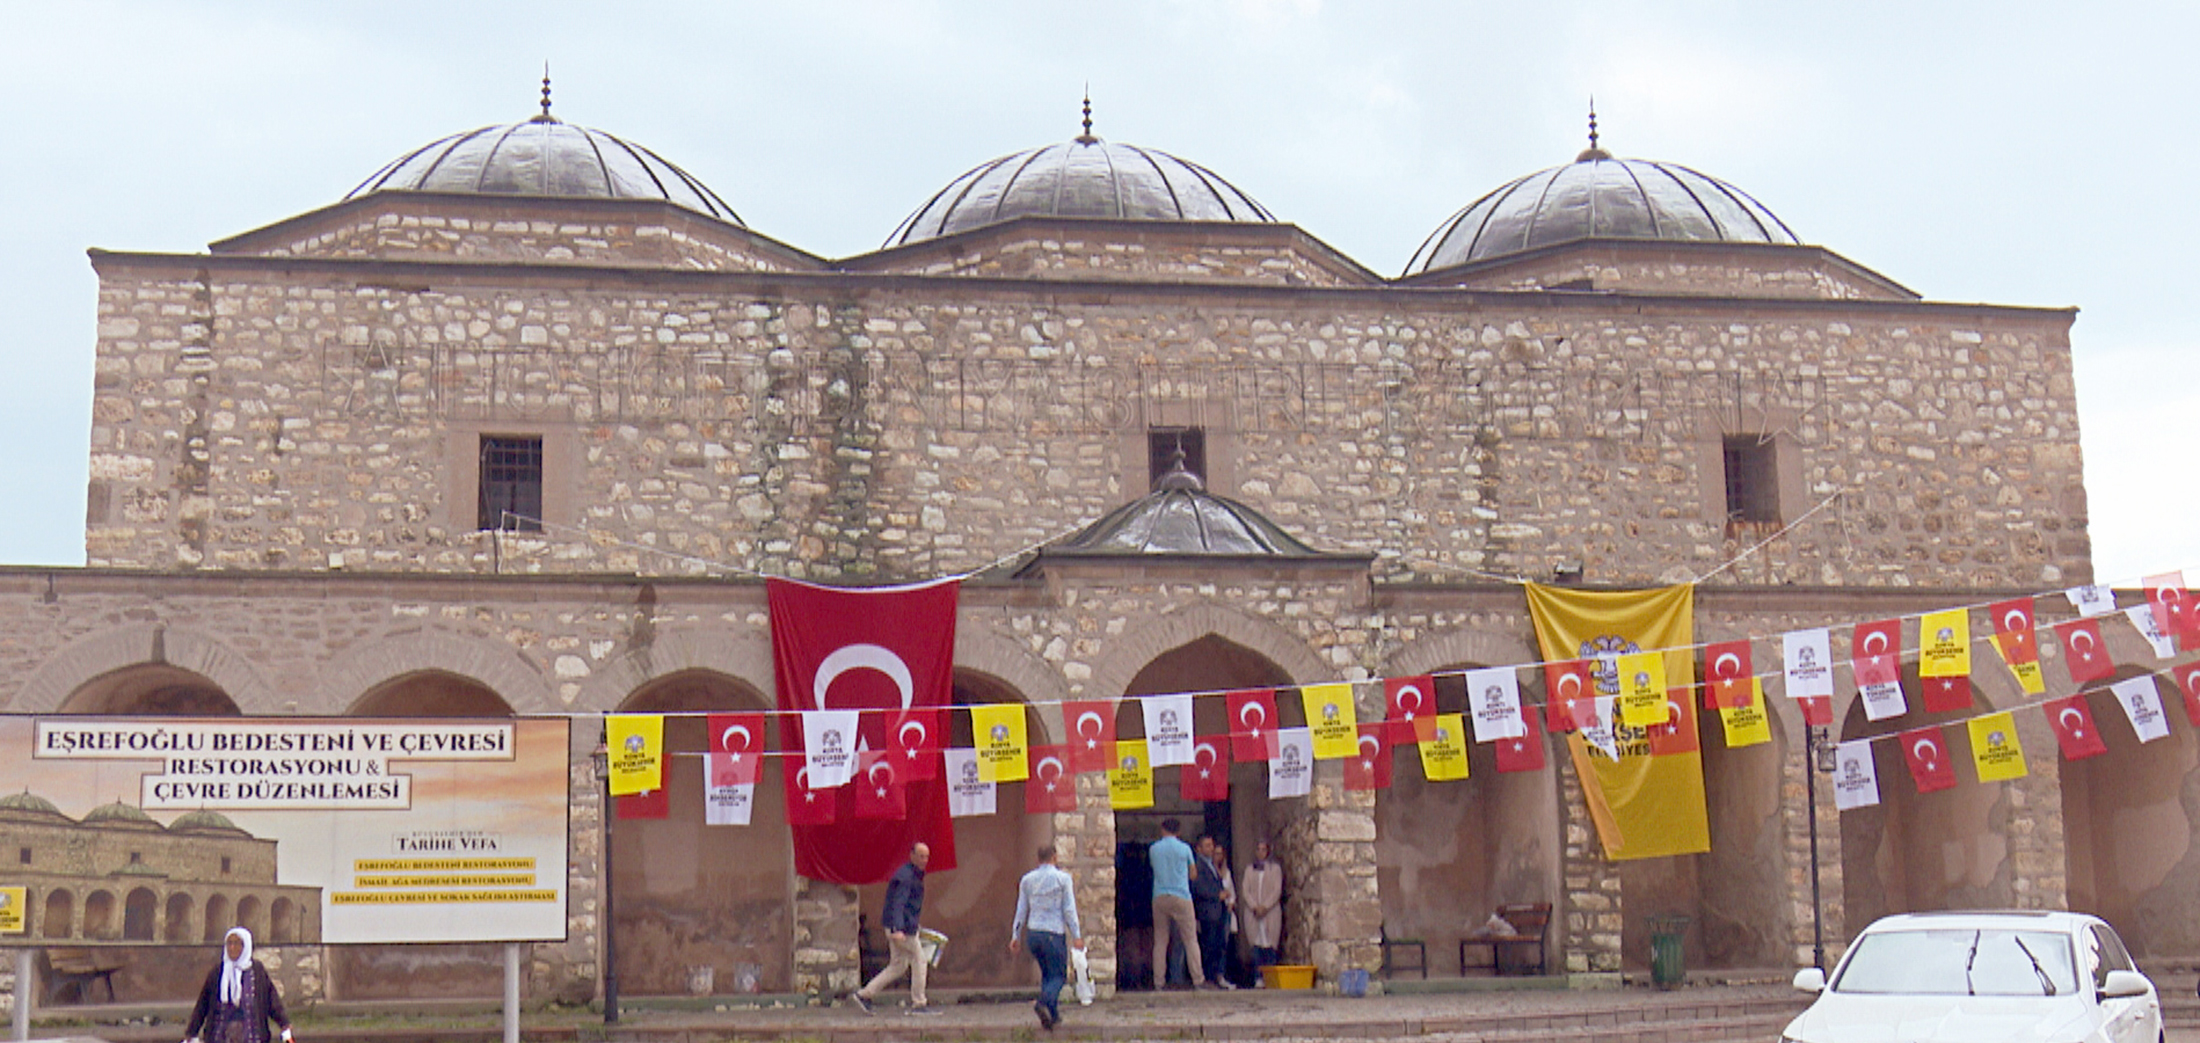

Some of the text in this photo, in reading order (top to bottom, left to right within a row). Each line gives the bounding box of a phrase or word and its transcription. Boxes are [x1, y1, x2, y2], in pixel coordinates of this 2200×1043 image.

[46, 728, 505, 755] EŞREFOĞLU BEDESTENİ VE ÇEVRESİ
[171, 758, 381, 775] RESTORASYONU &
[154, 779, 400, 802] ÇEVRE DÜZENLEMESİ
[396, 835, 497, 850] TARİHE VEFA
